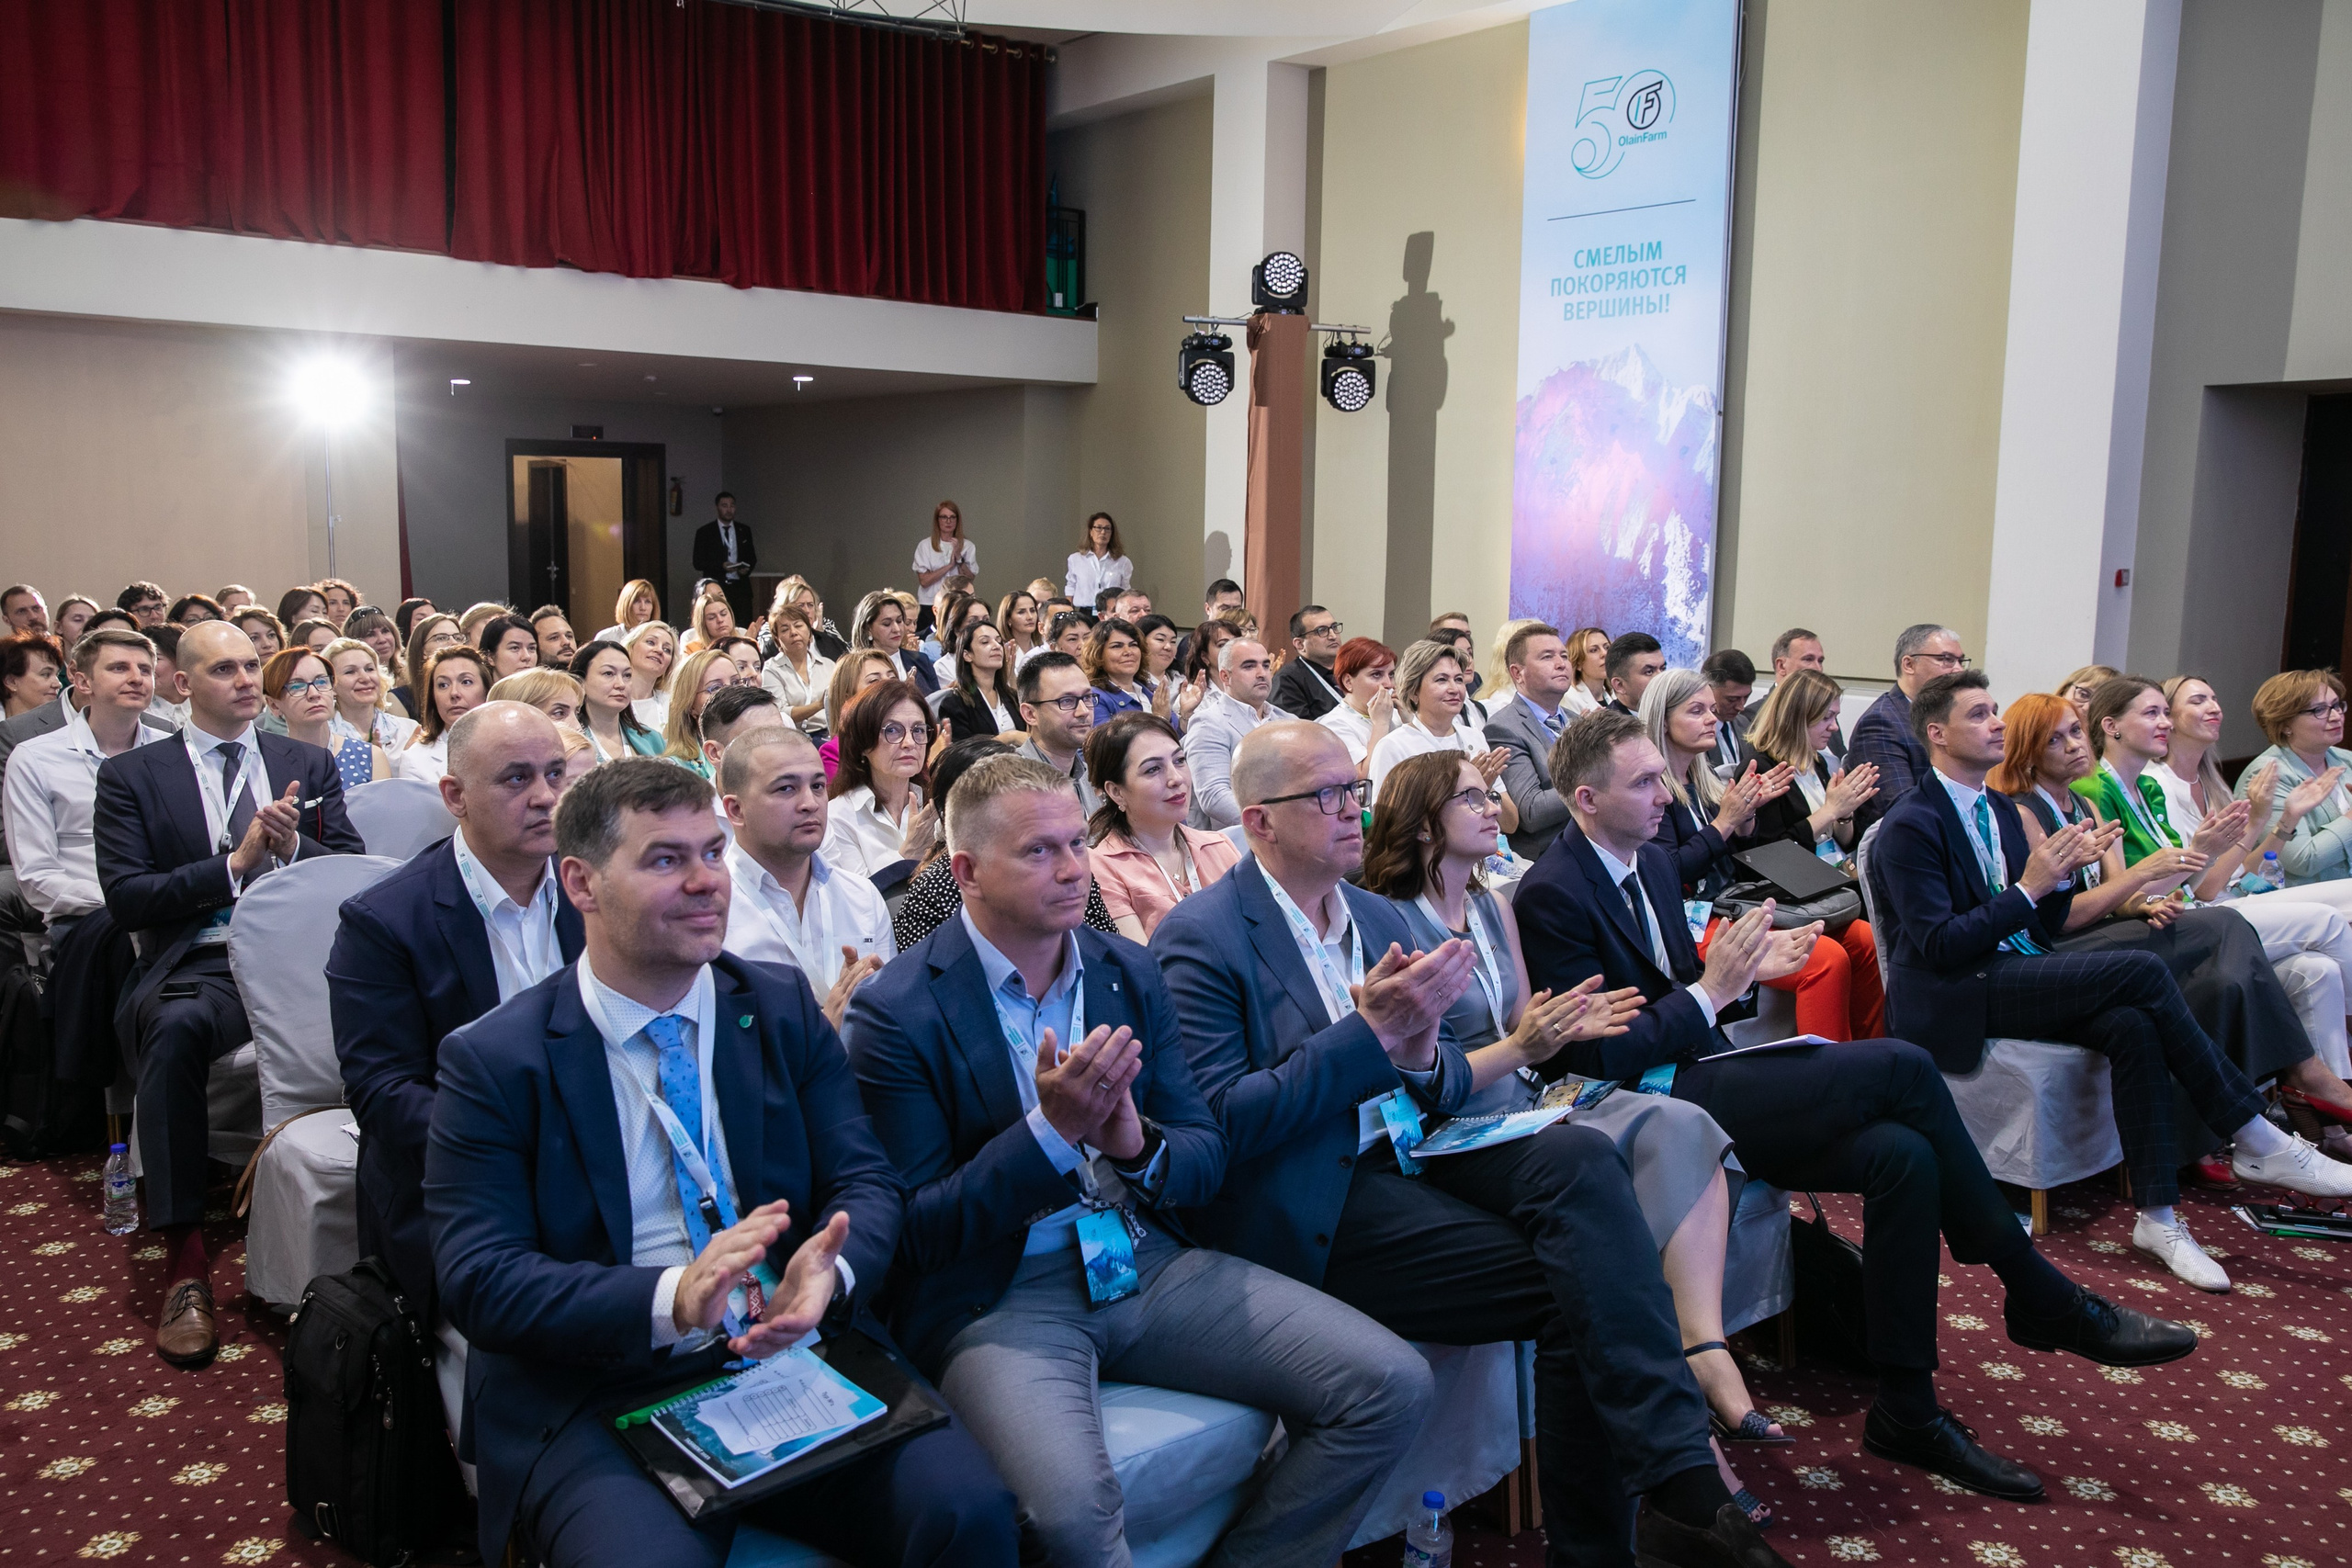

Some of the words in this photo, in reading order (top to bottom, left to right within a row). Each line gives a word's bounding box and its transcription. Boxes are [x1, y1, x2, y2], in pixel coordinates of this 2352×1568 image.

[1618, 130, 1668, 147] OlainFarm
[1574, 241, 1662, 269] СМЕЛЫМ
[1551, 265, 1687, 297] ПОКОРЯЮТСЯ
[1564, 293, 1670, 321] ВЕРШИНЫ!
